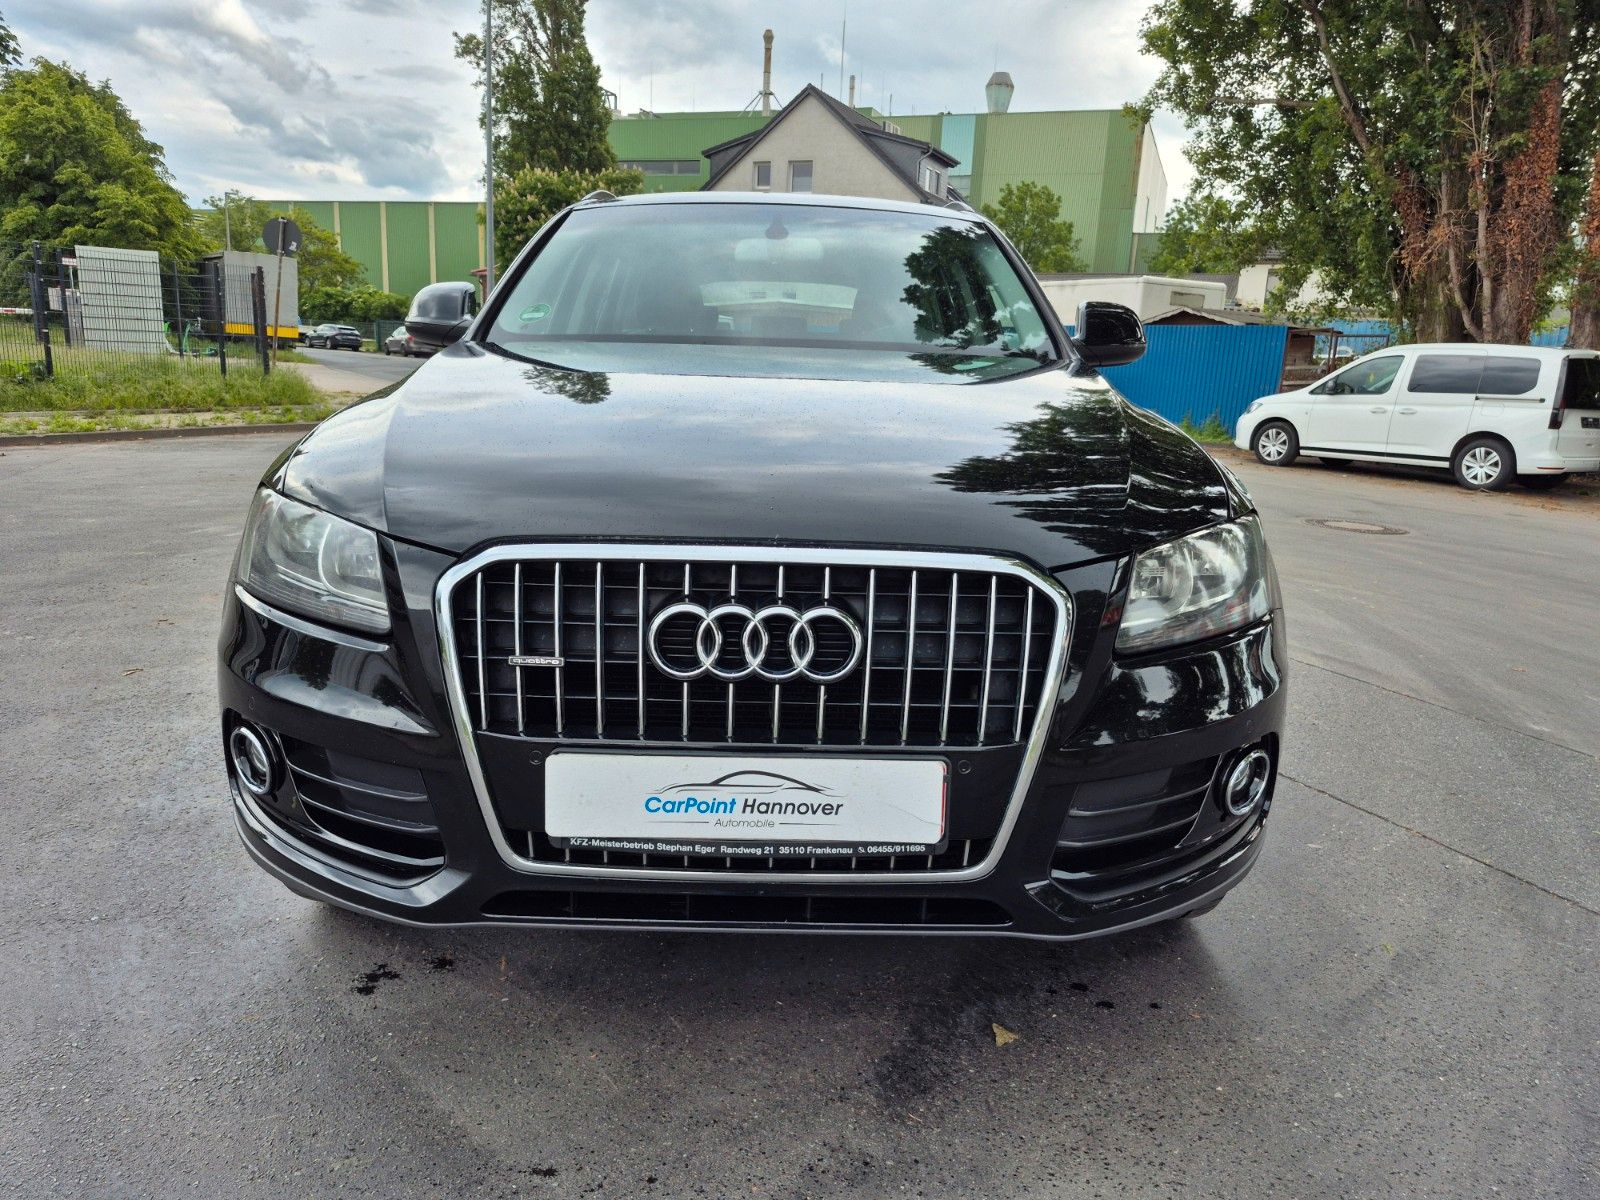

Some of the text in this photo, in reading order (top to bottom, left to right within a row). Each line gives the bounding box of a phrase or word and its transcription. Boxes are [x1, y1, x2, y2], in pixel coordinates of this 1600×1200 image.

[644, 796, 844, 816] CarPoint Hannover
[713, 818, 775, 828] Automobile
[570, 838, 926, 856] KFZ-Meisterbetrieb Stephan Eger Randweg 21 35110 Frankenau 06455/911695
